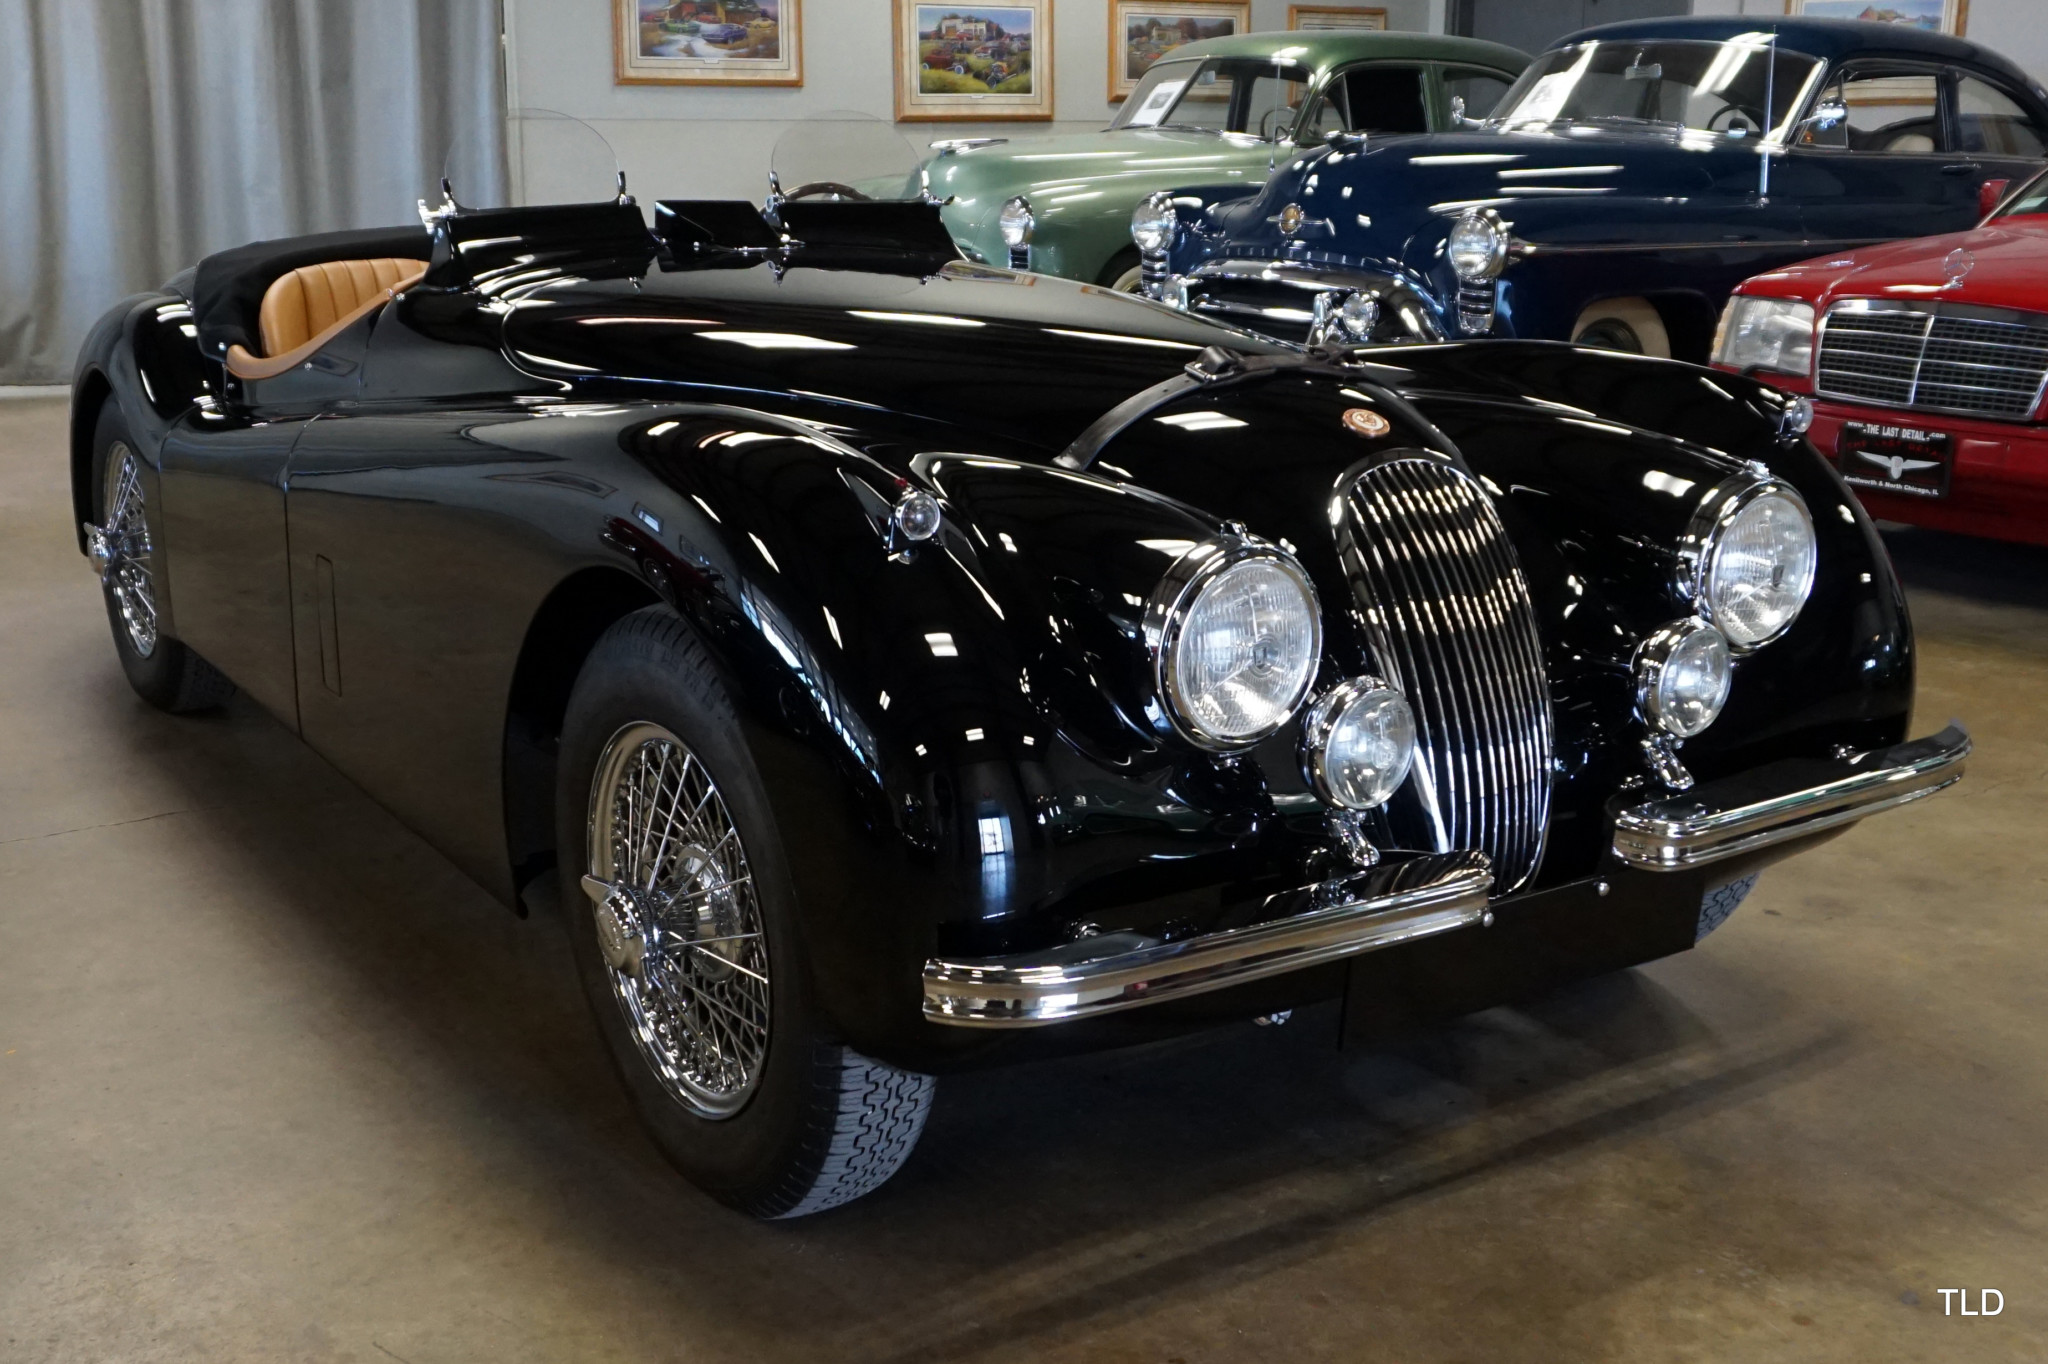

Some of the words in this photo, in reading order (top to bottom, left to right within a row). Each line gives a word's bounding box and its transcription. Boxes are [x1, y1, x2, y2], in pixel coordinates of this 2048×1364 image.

[1866, 423, 1880, 435] THE
[1882, 425, 1900, 437] LAST
[1901, 428, 1926, 441] DETAIL
[1843, 475, 1877, 486] Kenilworth
[1884, 481, 1903, 490] North
[1932, 488, 1939, 496] IL
